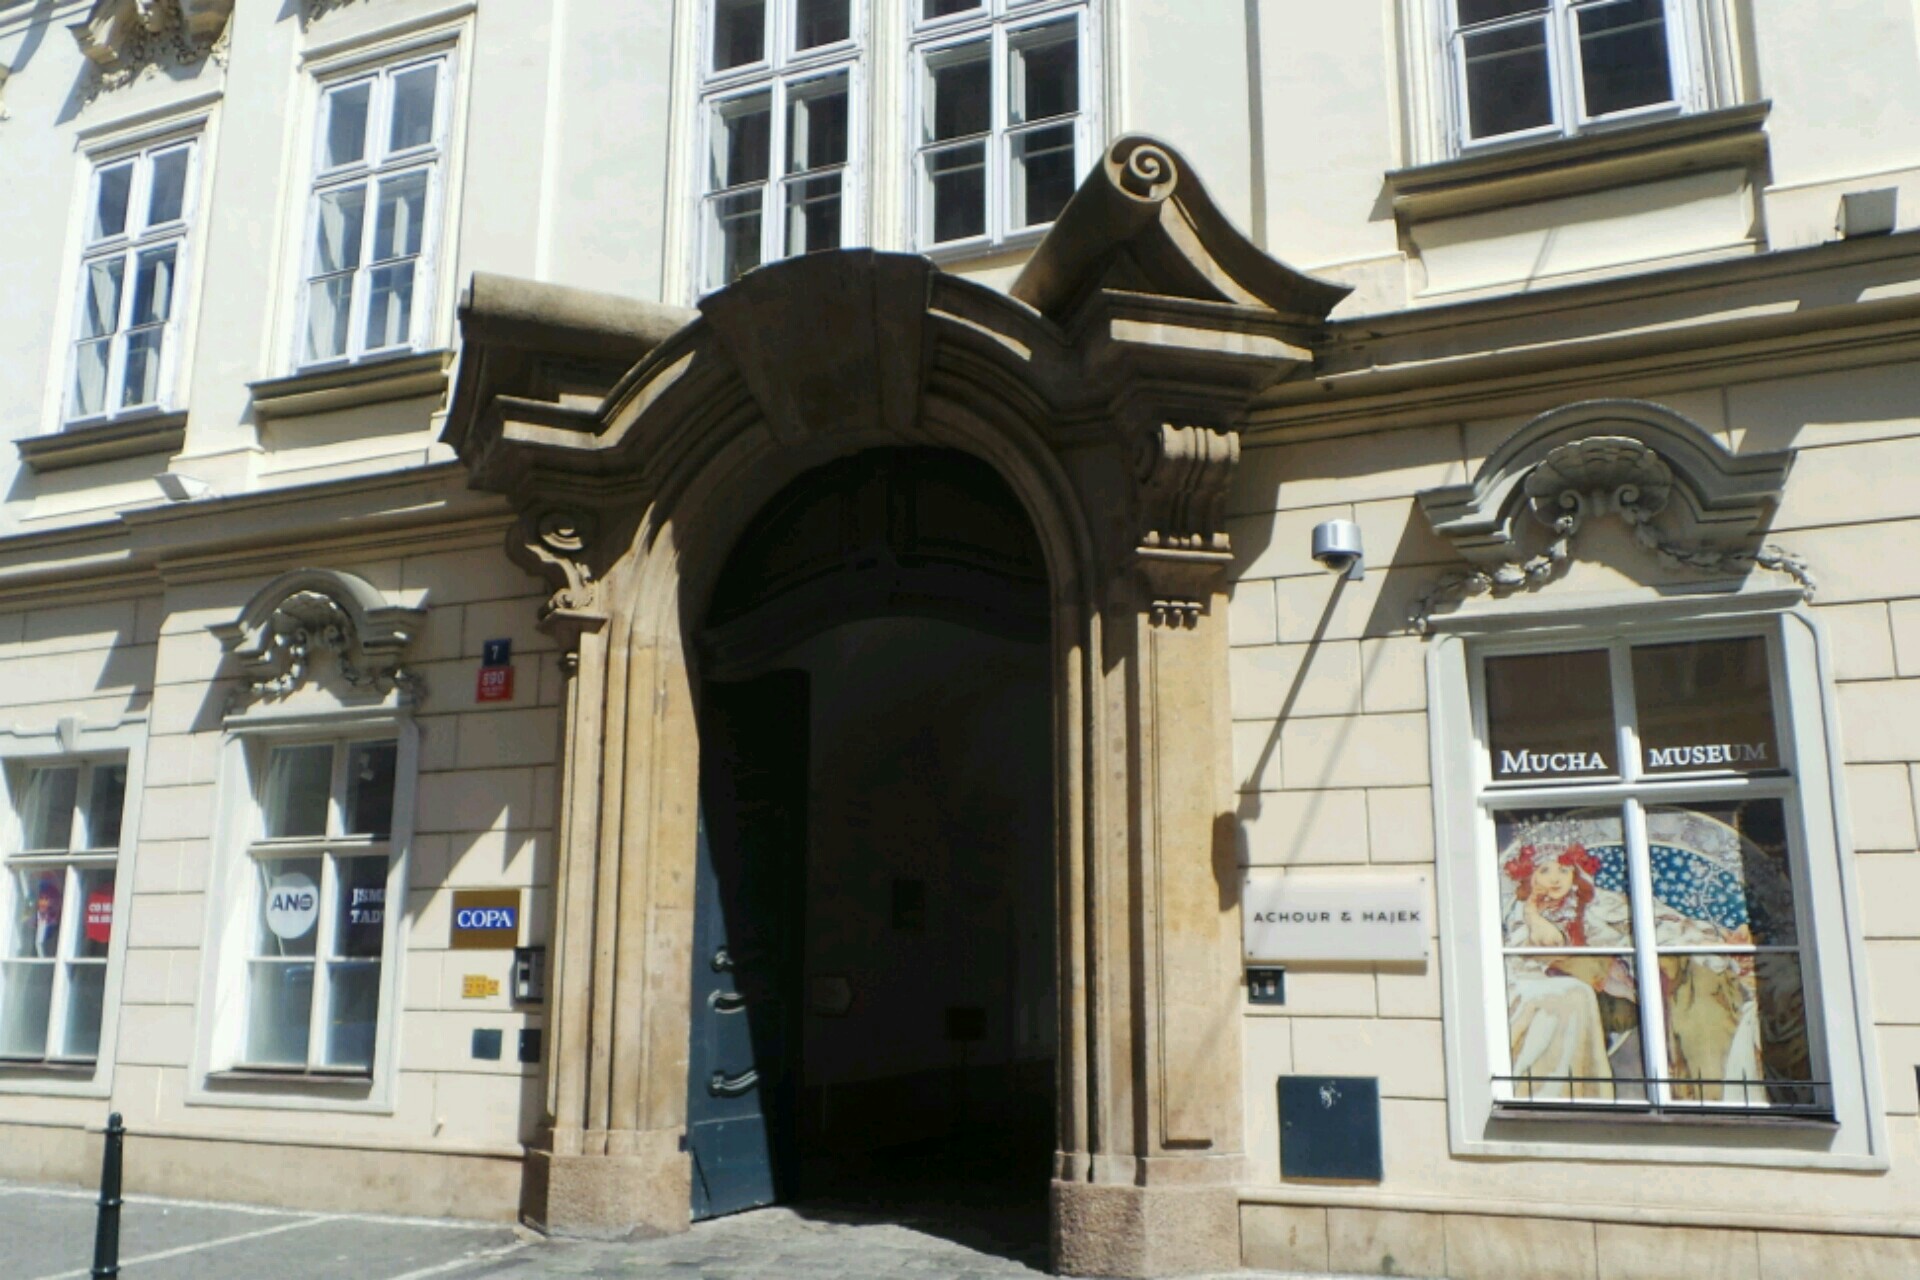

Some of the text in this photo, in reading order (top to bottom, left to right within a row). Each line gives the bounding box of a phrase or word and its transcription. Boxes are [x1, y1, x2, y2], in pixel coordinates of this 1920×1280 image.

[491, 645, 499, 660] 7
[1500, 742, 1768, 773] MUCHA MUSEUM
[271, 893, 315, 911] ANO
[457, 910, 513, 928] COPA
[1253, 910, 1421, 925] ACHOUR & HAJEK
